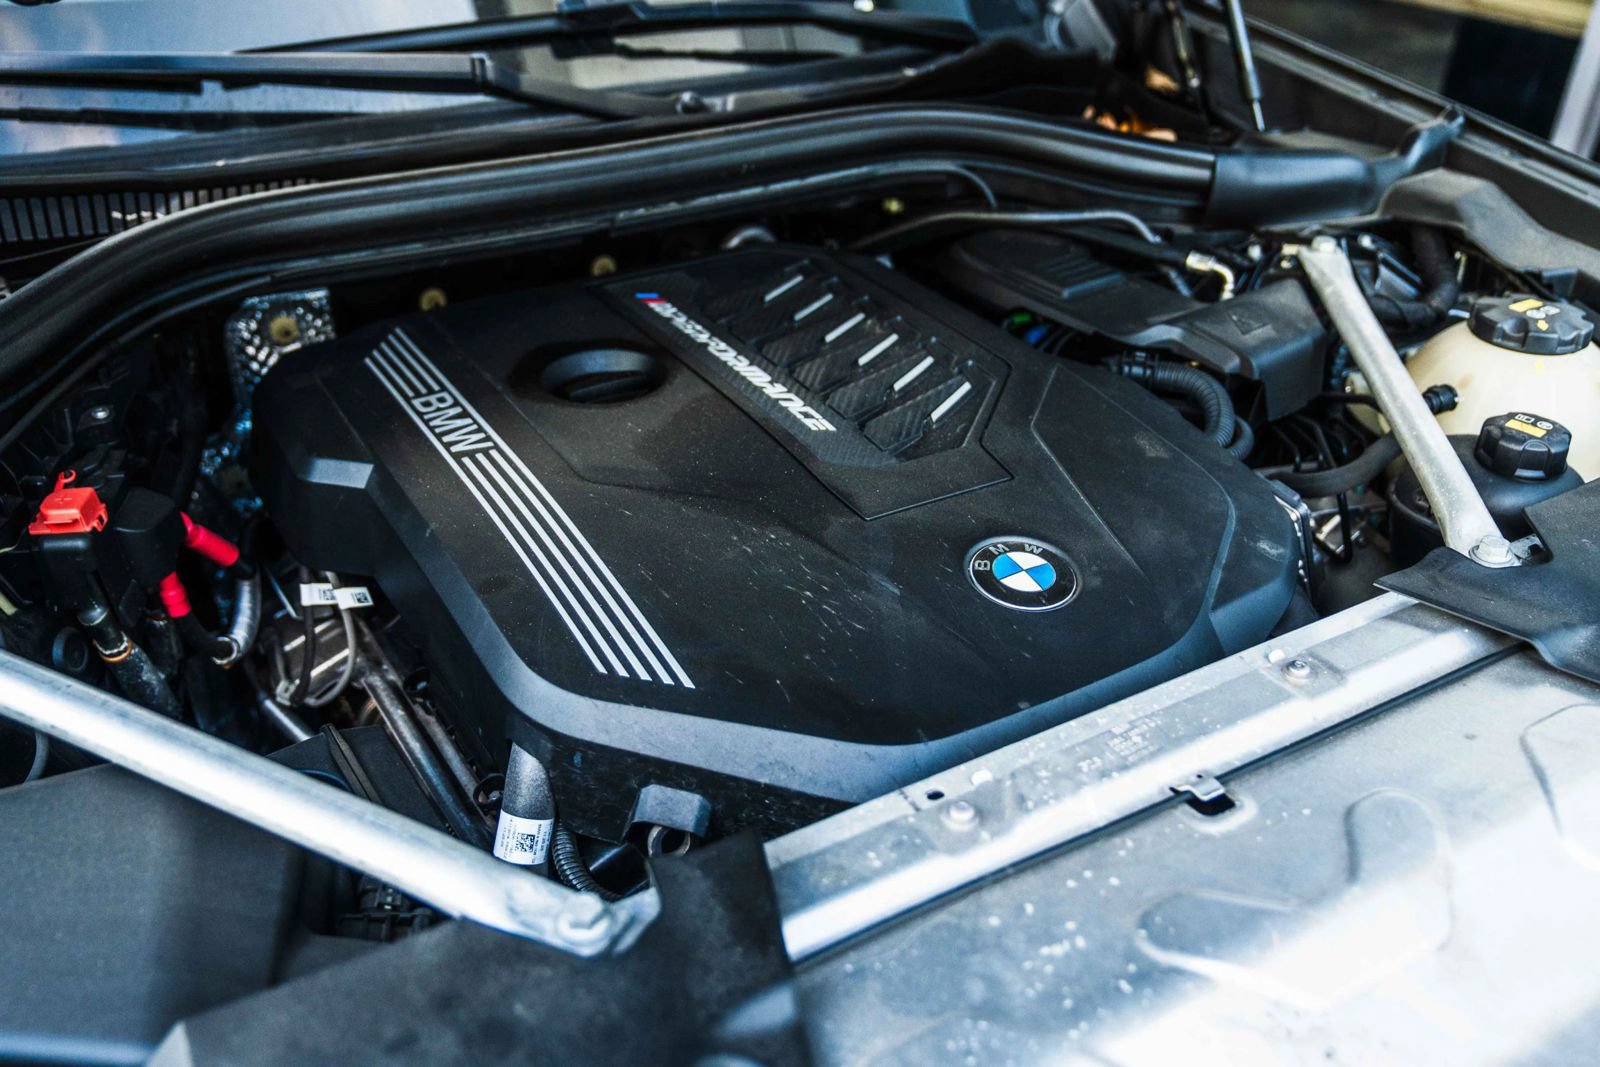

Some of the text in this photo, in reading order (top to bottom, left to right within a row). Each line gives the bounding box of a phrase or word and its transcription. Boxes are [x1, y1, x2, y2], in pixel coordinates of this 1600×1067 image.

[670, 311, 837, 432] PERFORMANCE
[410, 391, 495, 453] BMW
[974, 543, 1043, 571] BMW
